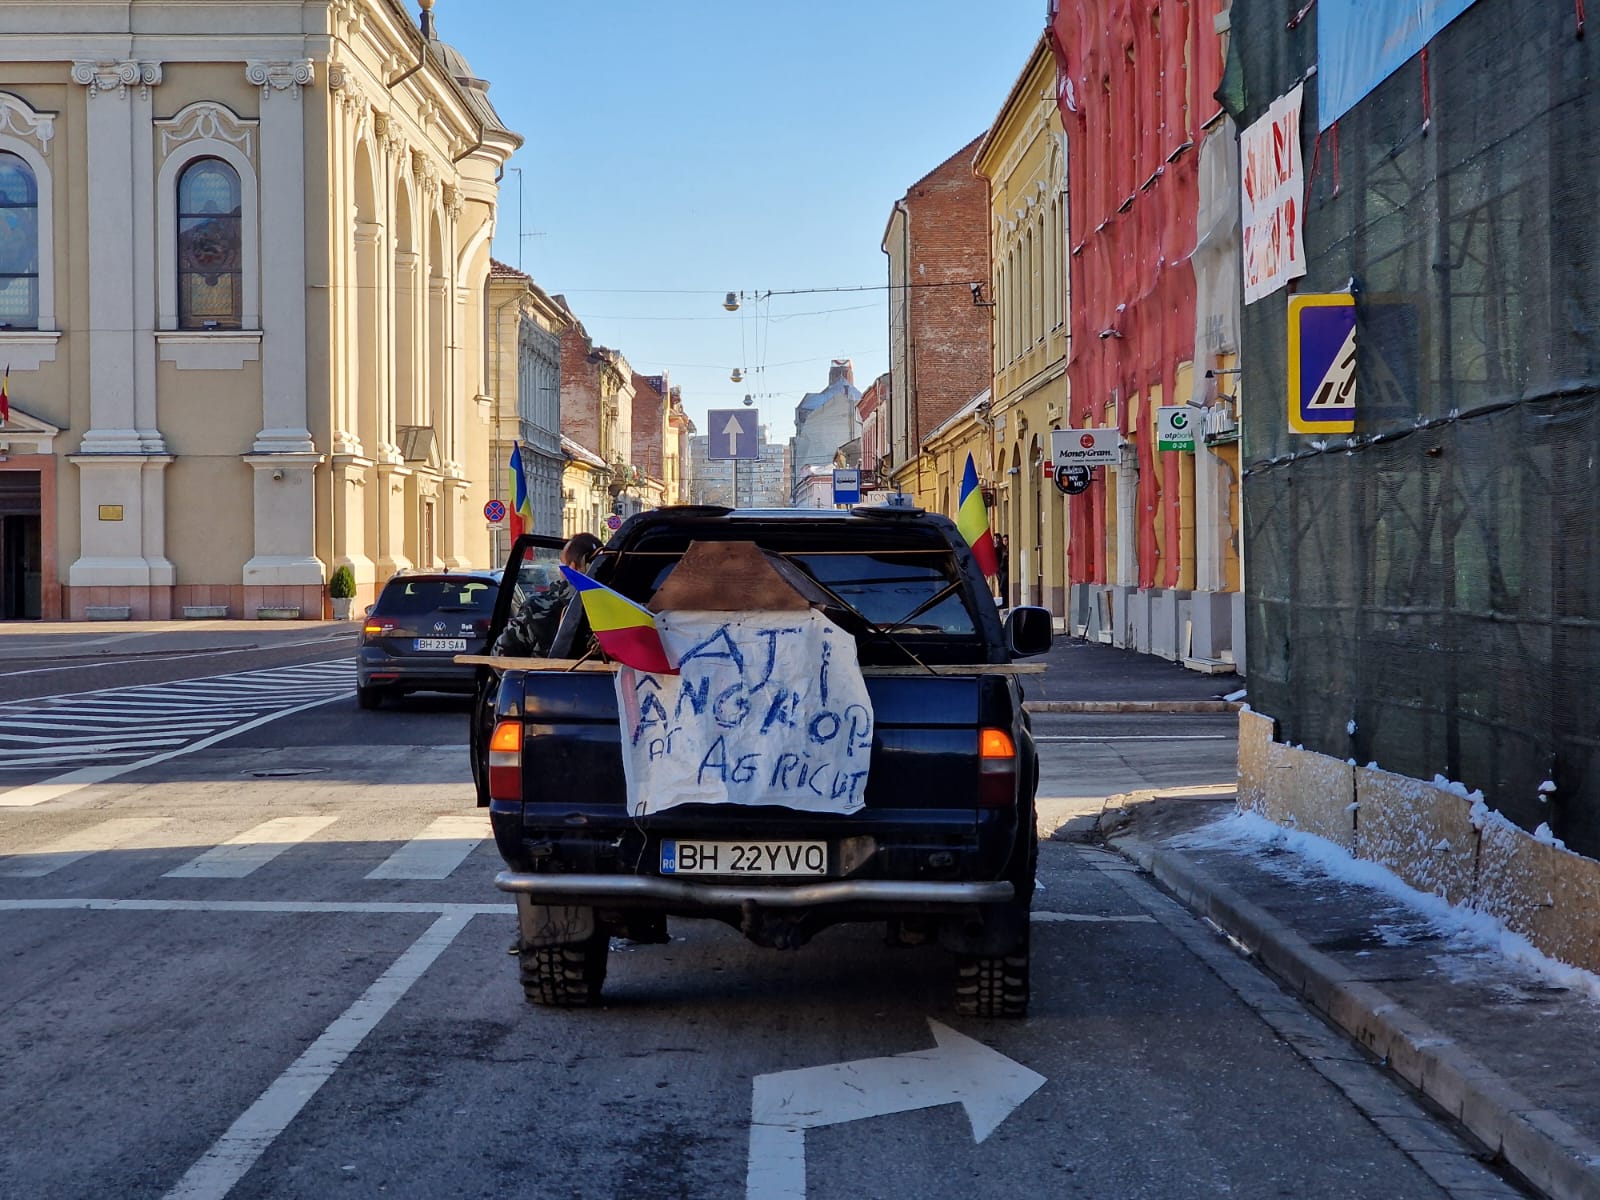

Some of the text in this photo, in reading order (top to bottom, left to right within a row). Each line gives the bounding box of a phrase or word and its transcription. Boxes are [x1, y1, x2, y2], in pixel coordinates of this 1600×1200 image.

[420, 641, 465, 649] BH 23 SAA
[678, 844, 718, 871] BH
[662, 858, 675, 869] RO
